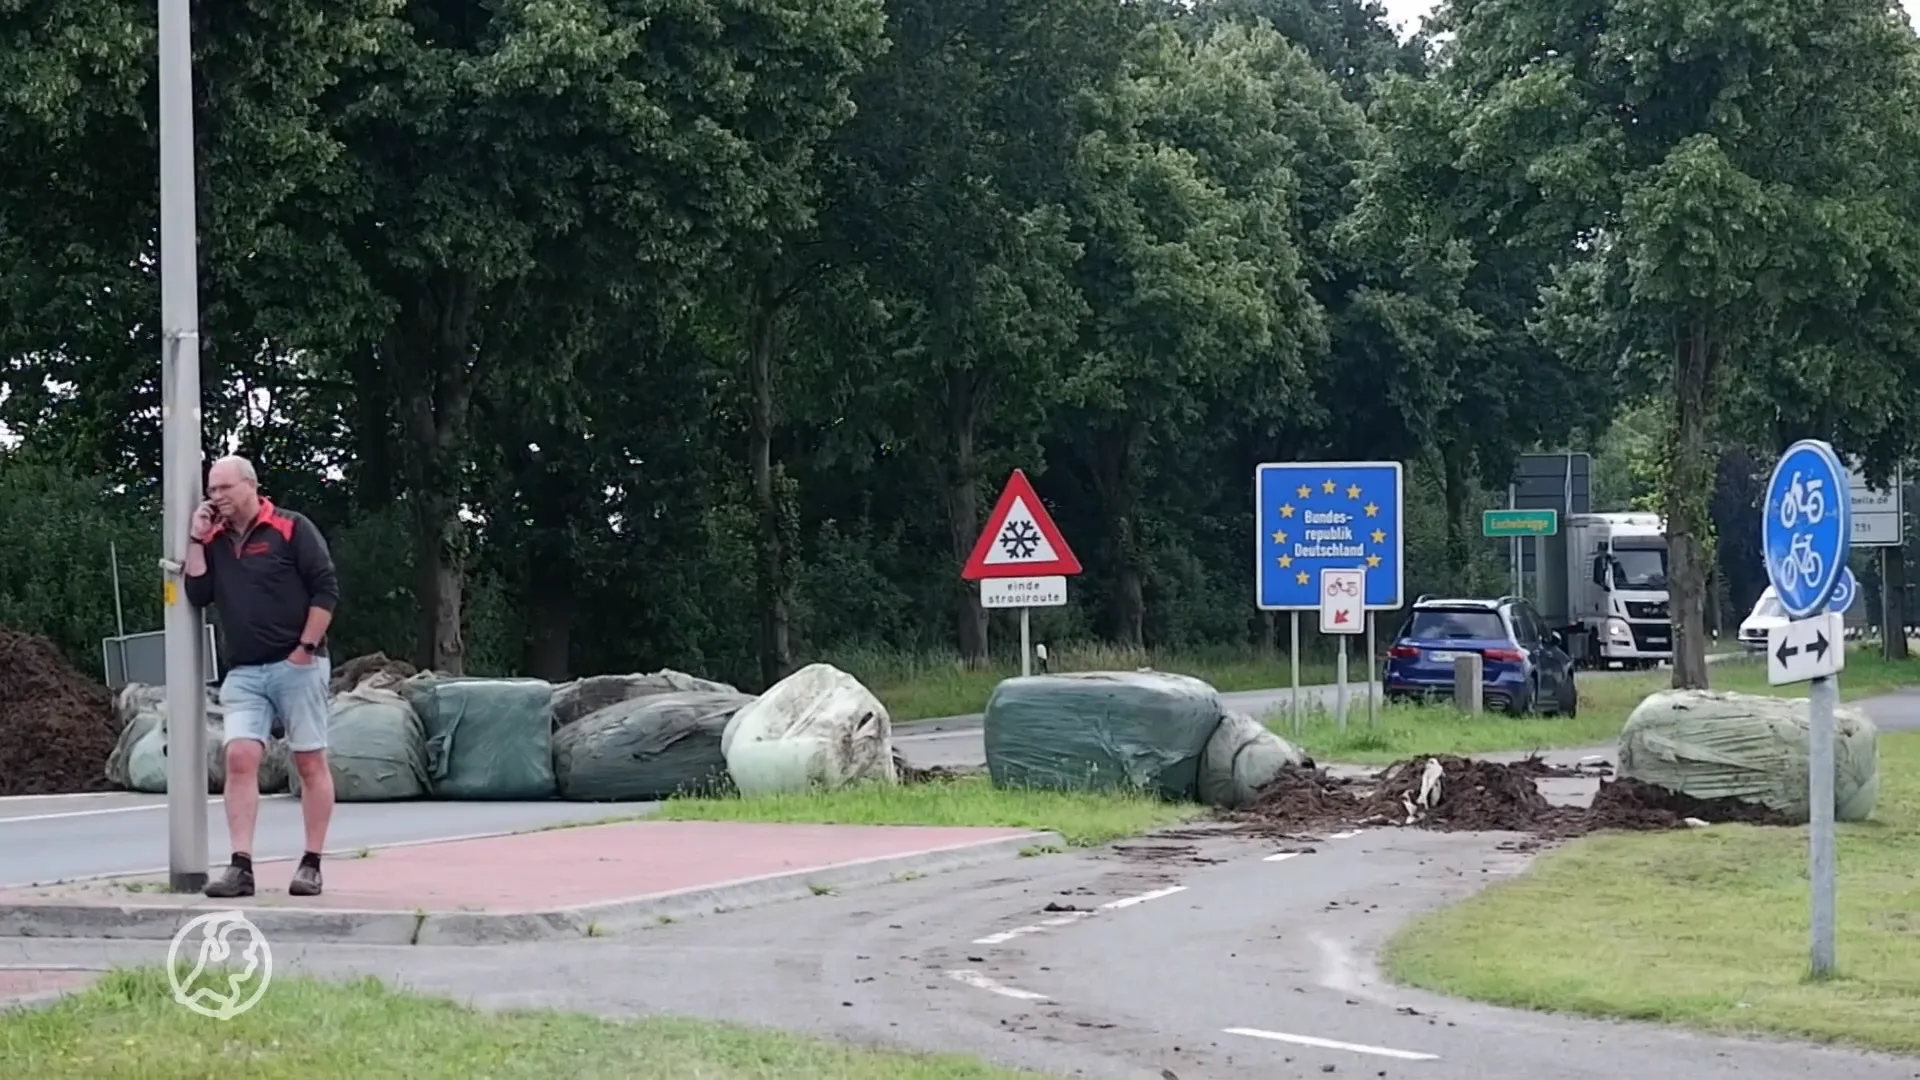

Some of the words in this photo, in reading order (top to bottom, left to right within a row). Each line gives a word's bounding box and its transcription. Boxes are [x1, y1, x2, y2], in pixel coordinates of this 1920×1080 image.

[1304, 509, 1354, 524] Bundes-
[1305, 526, 1353, 544] republik
[1294, 543, 1364, 557] Deutschland
[1007, 582, 1040, 591] einde
